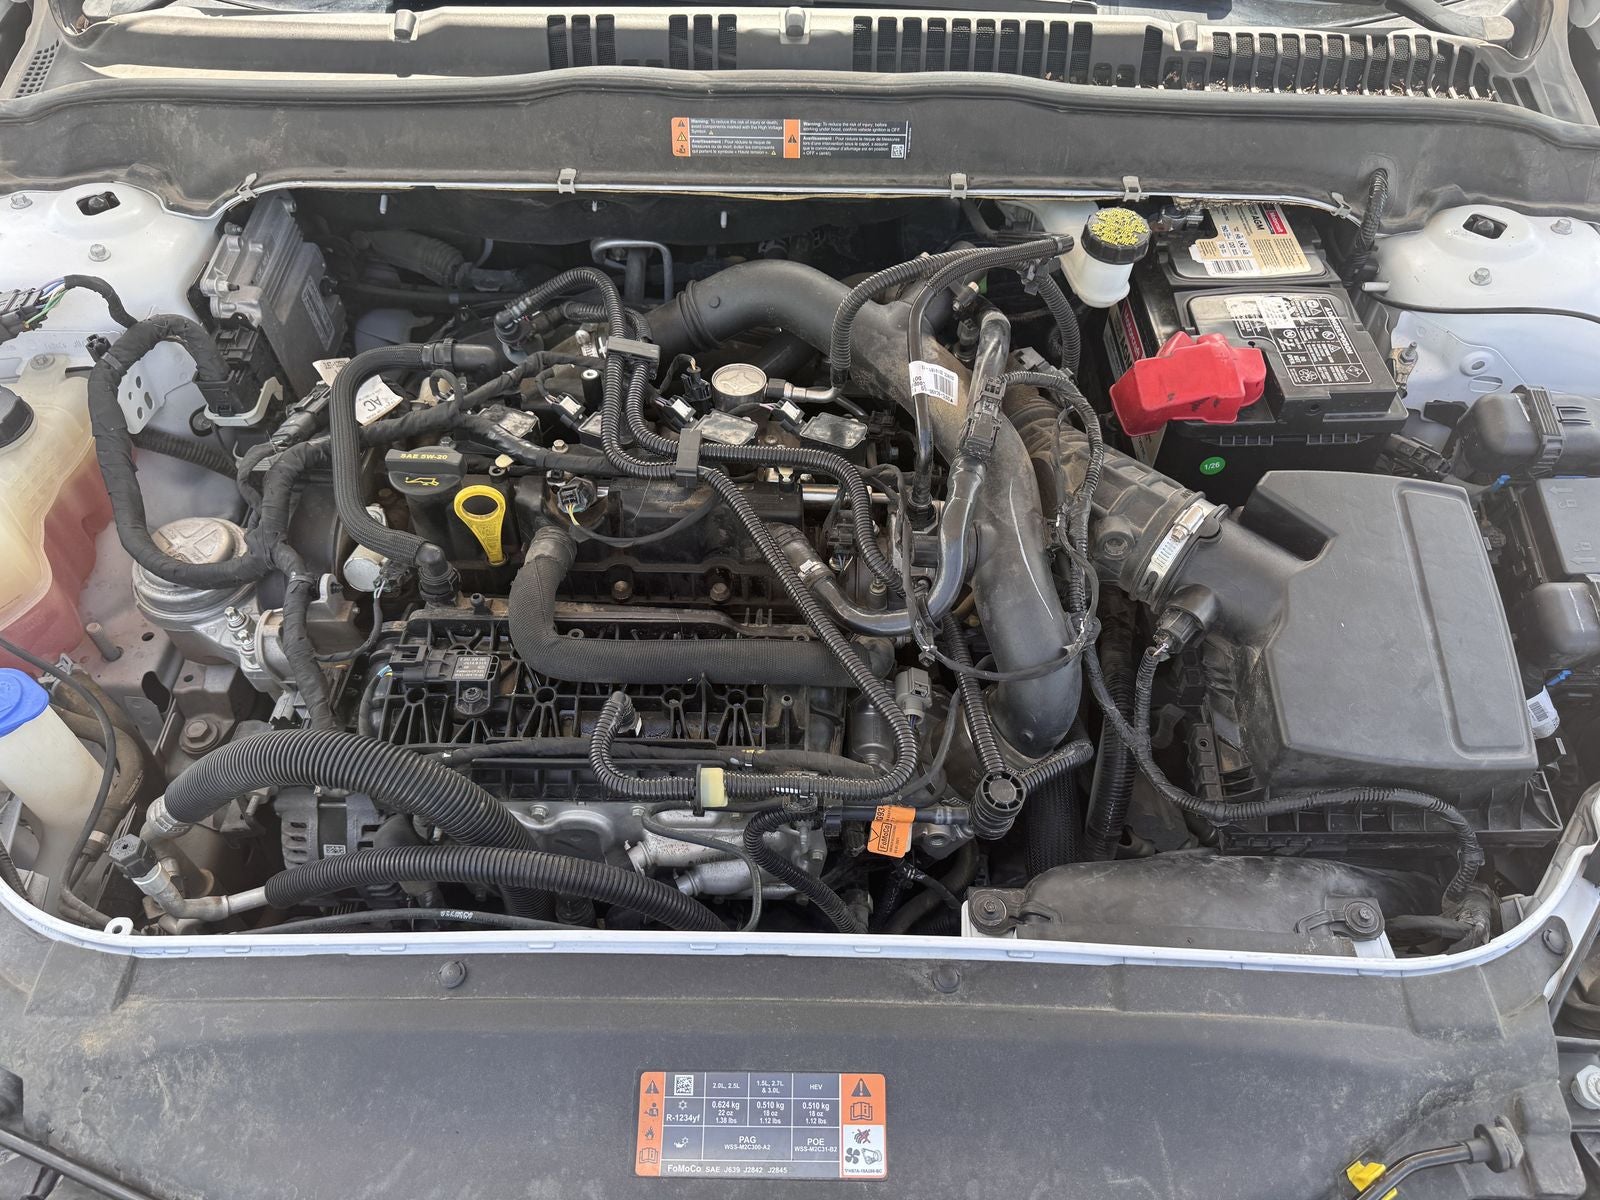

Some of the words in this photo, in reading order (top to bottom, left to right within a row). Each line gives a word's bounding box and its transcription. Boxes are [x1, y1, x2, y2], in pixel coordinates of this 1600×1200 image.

[1252, 215, 1265, 230] AGM
[363, 396, 382, 412] AC
[1204, 461, 1220, 470] 1/26
[880, 824, 890, 850] FoMoCo
[712, 1101, 730, 1109] 0.624
[731, 1101, 740, 1110] kg
[757, 1101, 775, 1109] 0.510
[776, 1102, 785, 1111] kg
[802, 1102, 821, 1110] 0.510
[822, 1103, 830, 1111] kg
[666, 1114, 700, 1123] R-1234yf
[739, 1136, 757, 1144] PAG
[807, 1138, 825, 1146] POE
[667, 1165, 702, 1173] FoMoCo
[724, 1166, 741, 1174] J639
[743, 1166, 763, 1174] J2842
[768, 1166, 788, 1174] J2845
